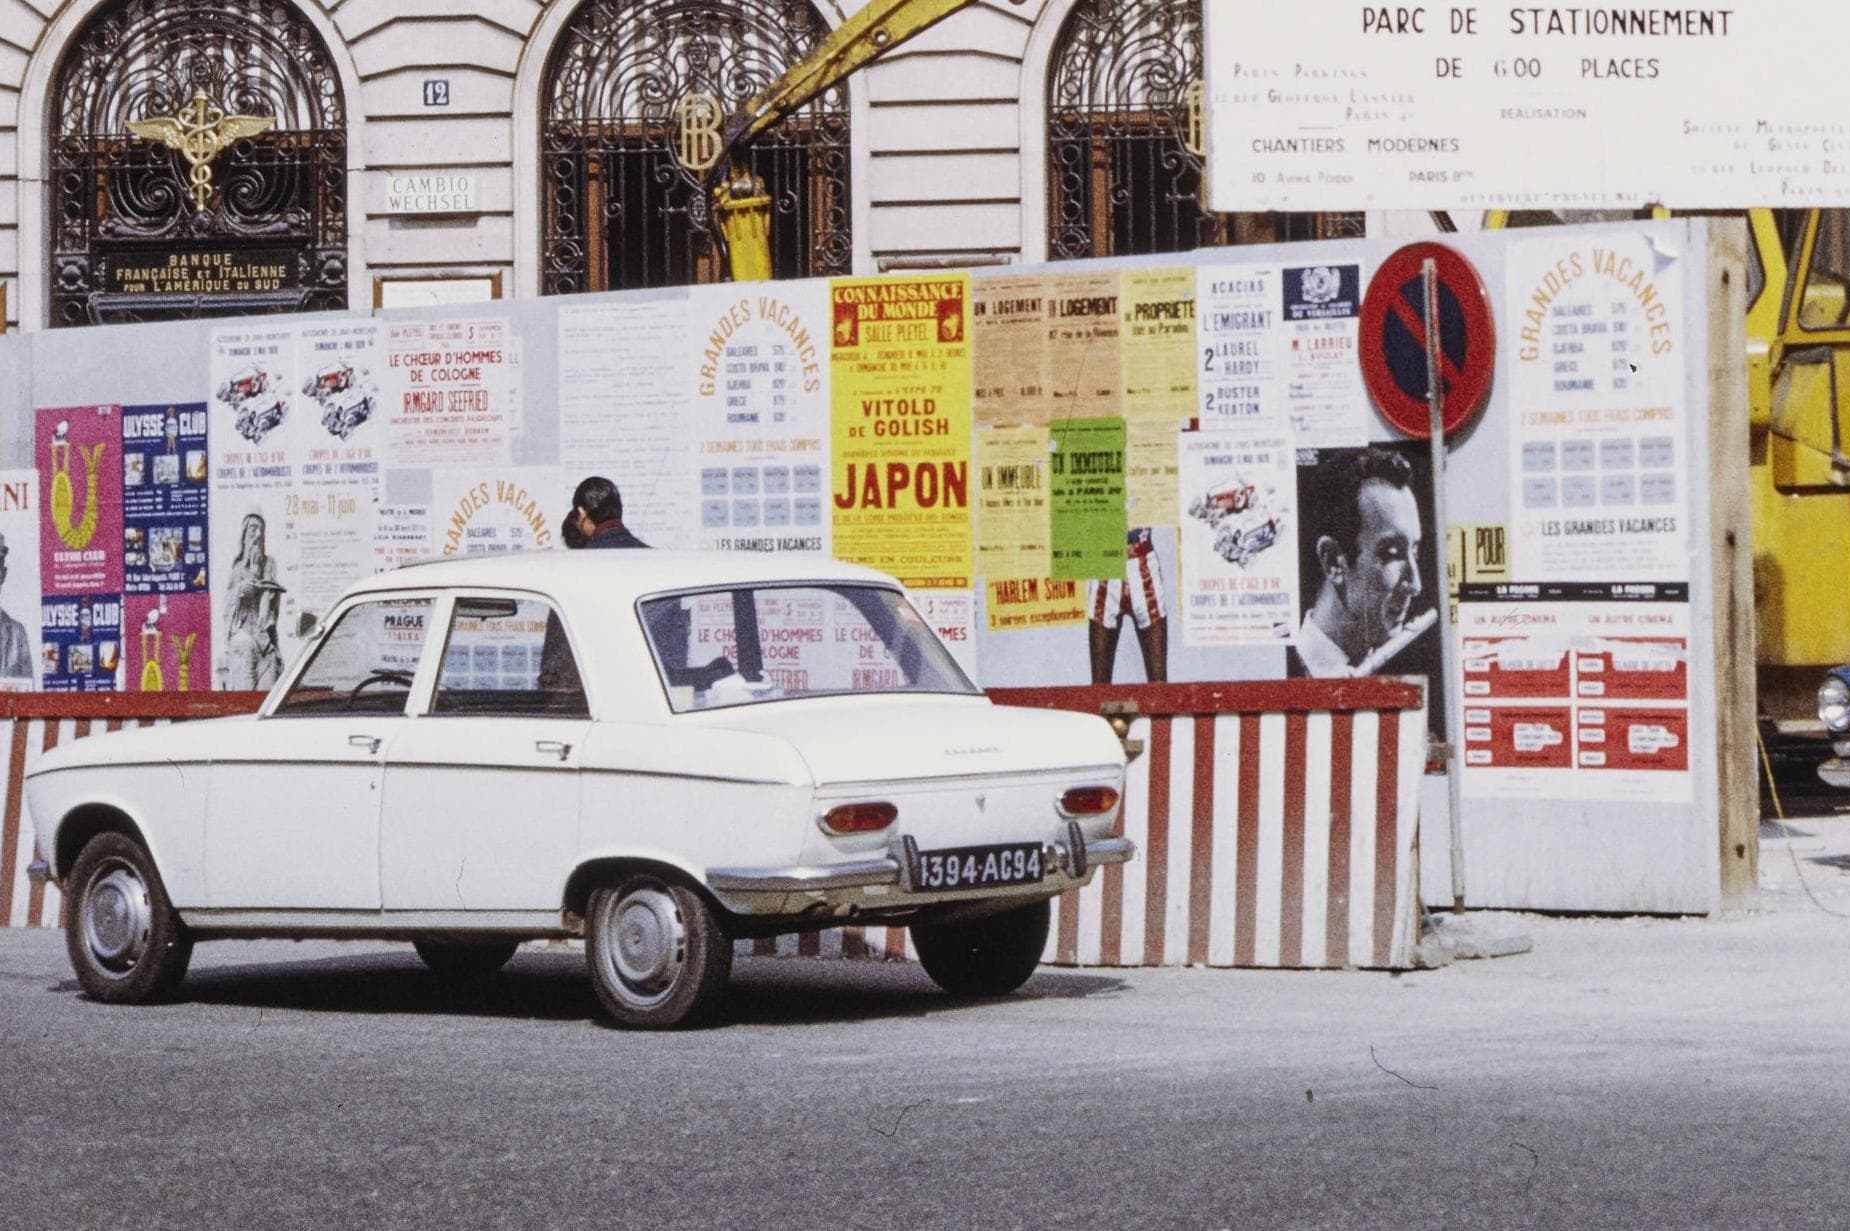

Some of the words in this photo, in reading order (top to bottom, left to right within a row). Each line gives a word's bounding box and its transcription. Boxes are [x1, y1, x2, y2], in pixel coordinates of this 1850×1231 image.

[1361, 7, 1426, 35] PARC
[1450, 7, 1478, 36] DE
[1509, 8, 1735, 37] STATIONNEMENT
[1435, 56, 1463, 79] DE
[1581, 57, 1660, 80] PLACES
[426, 83, 449, 105] 12
[1251, 137, 1345, 154] CHANTIERS
[1367, 137, 1460, 154] MODERNES
[392, 176, 470, 194] CAMBIO
[1408, 170, 1448, 184] PARIS
[388, 193, 475, 211] WECHSEL
[169, 253, 233, 267] BANQUE
[116, 267, 189, 282] FRANÇAISE
[219, 264, 287, 279] ITALIENNE
[123, 283, 145, 292] POUR
[237, 281, 249, 290] DU
[254, 278, 281, 290] SUD
[834, 283, 962, 303] CONNAISSANCE
[1211, 279, 1265, 295] ACACIAS
[857, 302, 879, 320] DU
[882, 300, 938, 319] MONDE
[992, 297, 1043, 316] LOGEMENT
[1060, 296, 1118, 317] LOGEMENT
[1135, 299, 1195, 320] PROPRIETE
[1520, 251, 1583, 362] GRANDES
[1592, 248, 1673, 357] VACANCES
[866, 323, 893, 343] SALLE
[897, 322, 929, 342] PLEYEL
[700, 299, 752, 397] GRANDES
[759, 296, 821, 394] VACANCES
[1204, 347, 1215, 372] 2
[1216, 340, 1260, 358] LAUREL
[389, 353, 399, 368] LE
[445, 350, 503, 366] D'HOMMES
[1224, 359, 1260, 376] HARDY
[410, 369, 423, 383] DE
[431, 367, 482, 382] COLOGNE
[448, 388, 489, 413] SEEFRIED
[862, 398, 936, 417] VITOLD
[1205, 392, 1215, 411] 2
[1217, 385, 1260, 400] BUSTER
[1218, 402, 1261, 416] KEATON
[123, 412, 165, 438] ULYSSE
[178, 411, 207, 436] CLUB
[849, 426, 866, 438] DE
[874, 418, 950, 437] GOLISH
[833, 460, 968, 510] JAPON
[286, 494, 301, 516] 28
[443, 481, 490, 556] RANDES
[496, 480, 554, 551] VACANC
[1542, 521, 1561, 537] LES
[1564, 519, 1615, 536] GRANDES
[1618, 516, 1677, 535] VACANCES
[734, 538, 775, 553] GRANDES
[777, 537, 822, 552] VACANCES
[1476, 526, 1505, 566] POUR
[1045, 577, 1076, 601] SHOW
[92, 602, 120, 627] CLUB
[384, 615, 424, 629] PRAGUE
[699, 628, 710, 642] LE
[835, 628, 848, 642] LE
[763, 646, 800, 660] LOGNE
[859, 646, 875, 659] DE
